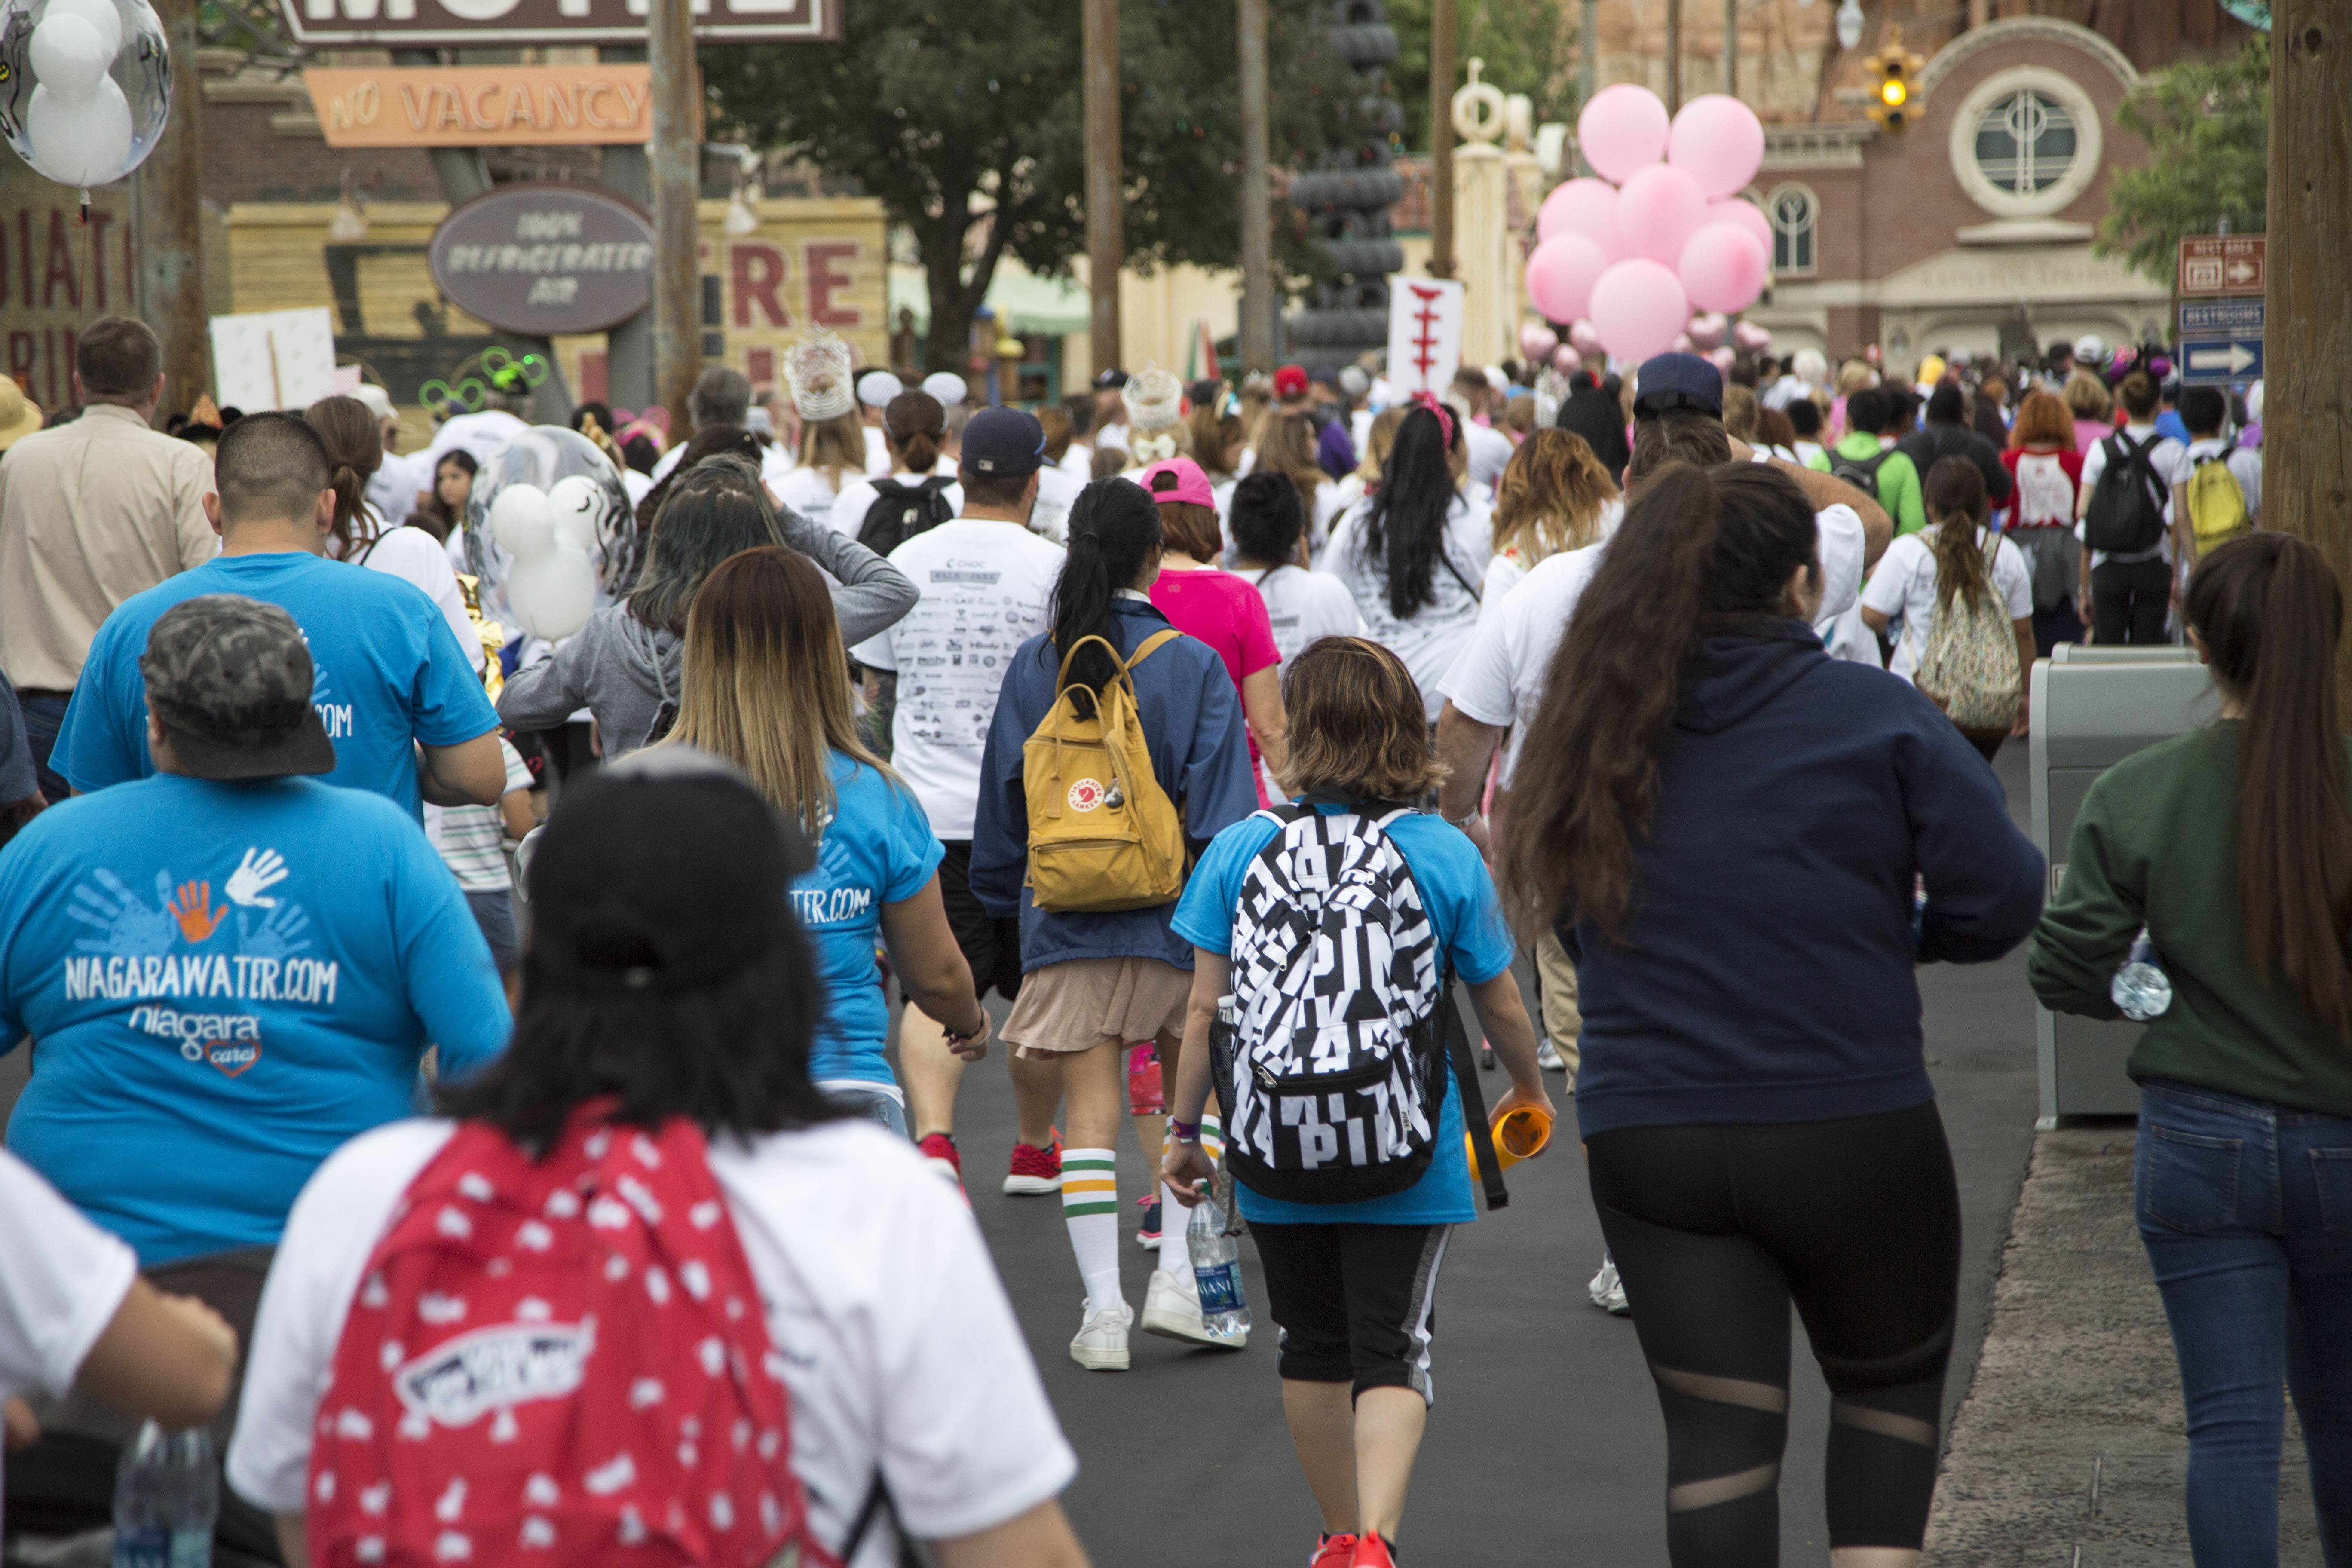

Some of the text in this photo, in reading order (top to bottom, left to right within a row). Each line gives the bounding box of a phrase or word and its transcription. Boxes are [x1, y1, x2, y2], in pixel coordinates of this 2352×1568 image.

[329, 81, 651, 131] NO VACANCY
[2186, 305, 2262, 325] RESTROOMS
[65, 955, 338, 1004] NIAGARAWATER.COM
[129, 1004, 262, 1061] niagara
